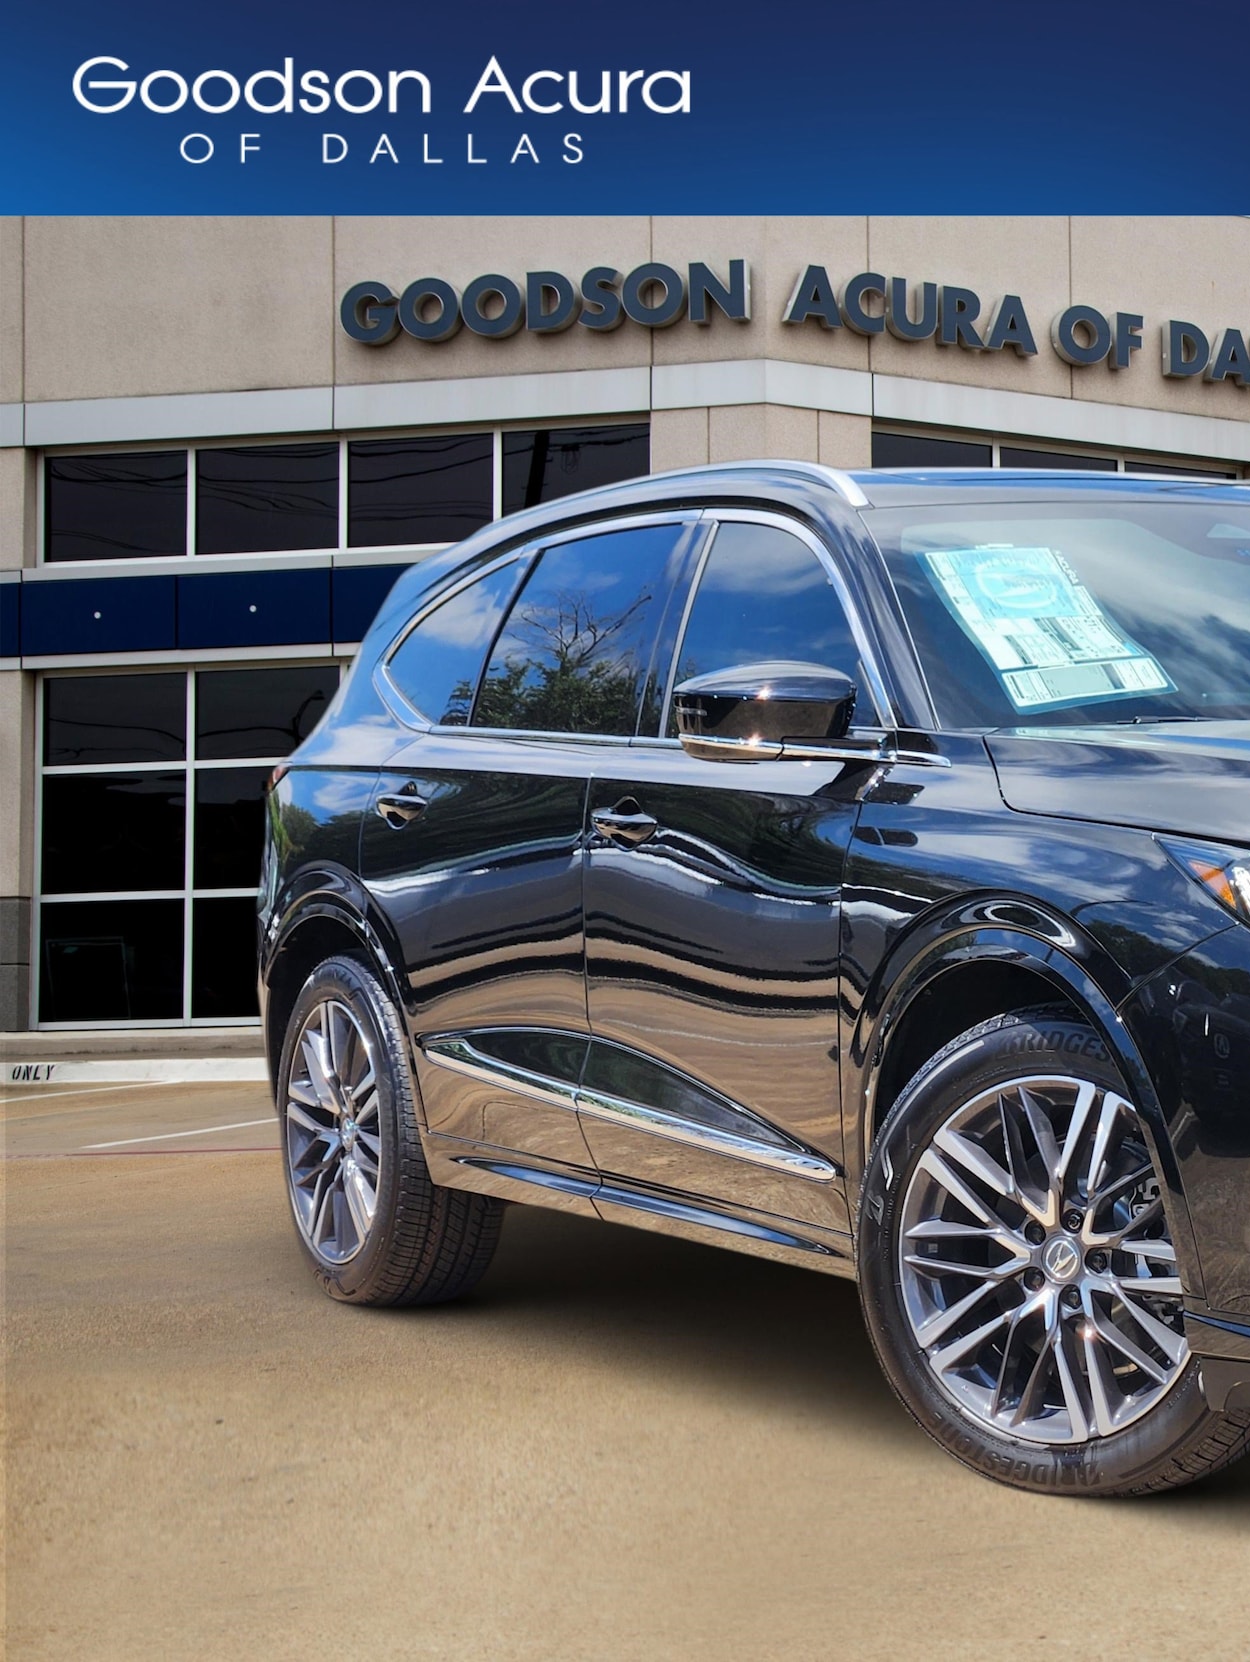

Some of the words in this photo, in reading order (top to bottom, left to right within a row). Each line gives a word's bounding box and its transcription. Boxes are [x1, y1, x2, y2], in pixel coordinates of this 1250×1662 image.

[340, 259, 751, 346] GOODSON
[783, 264, 1038, 356] ACURA
[1052, 305, 1144, 369] OF
[12, 1065, 55, 1081] ONLY
